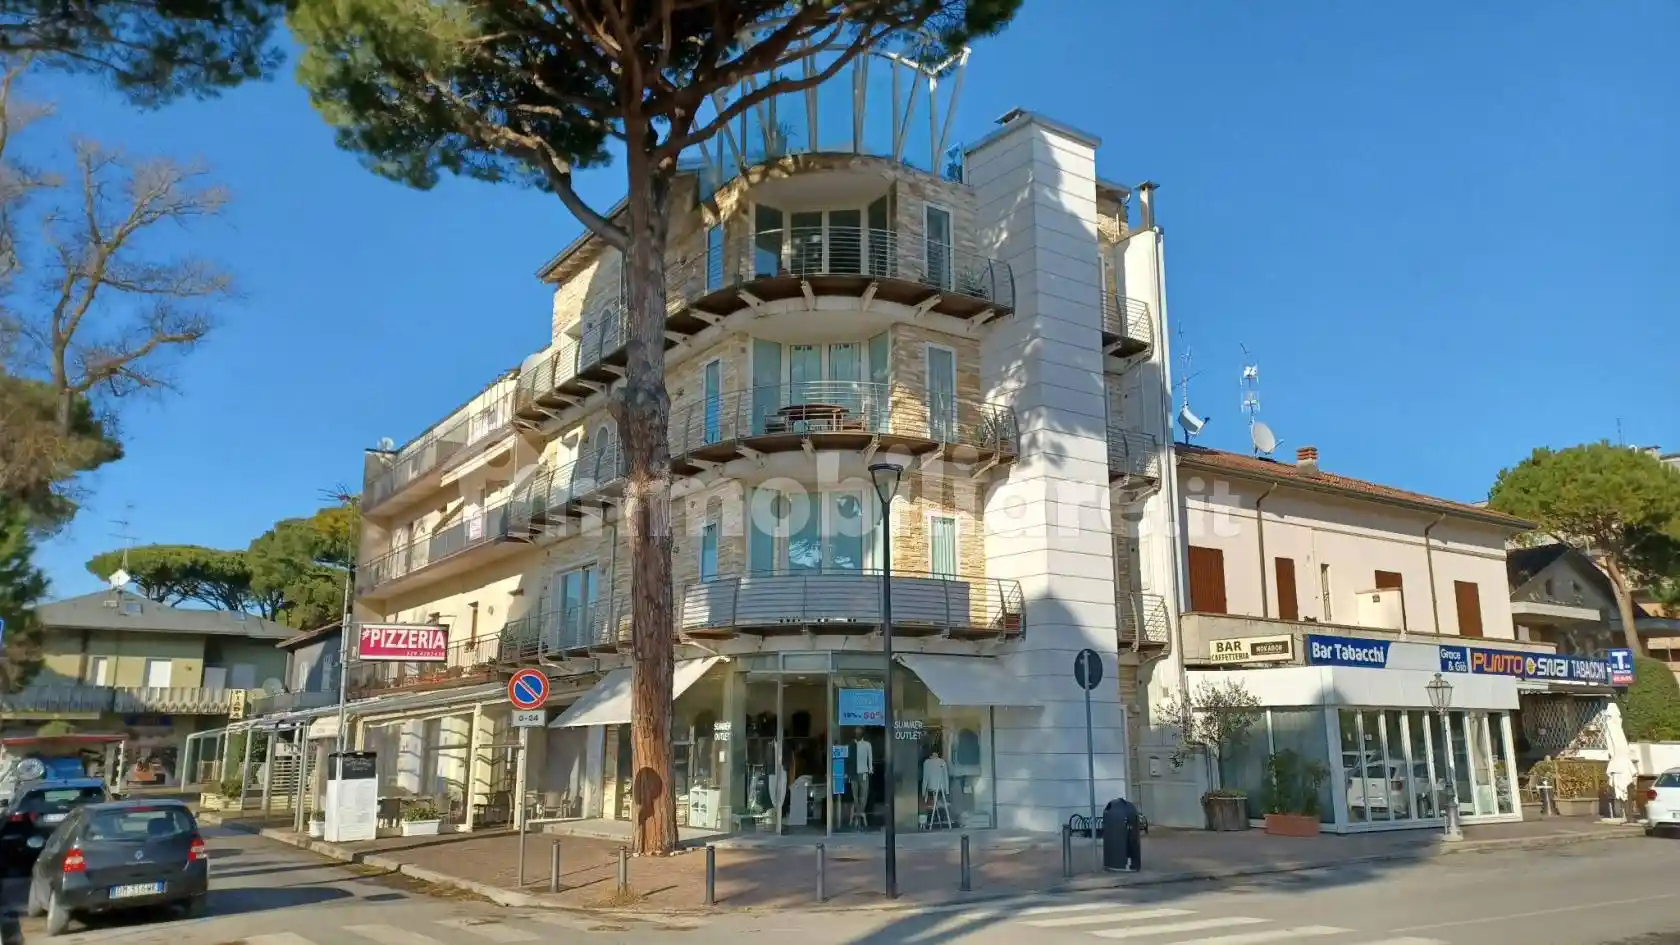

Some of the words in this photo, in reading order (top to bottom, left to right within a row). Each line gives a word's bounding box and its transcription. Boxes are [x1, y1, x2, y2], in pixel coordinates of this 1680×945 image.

[369, 628, 446, 650] PIZZERIA
[1216, 641, 1242, 653] BAR
[1312, 641, 1333, 659] Bar
[1334, 643, 1385, 663] Tabacchi
[1211, 652, 1250, 662] CAFFETTERIA
[1611, 651, 1628, 670] T
[1472, 652, 1524, 674] PUNTO
[1571, 659, 1606, 680] TABACCHI
[518, 714, 539, 722] 0-24
[893, 720, 923, 729] SUMMER
[894, 731, 921, 740] OUTLET
